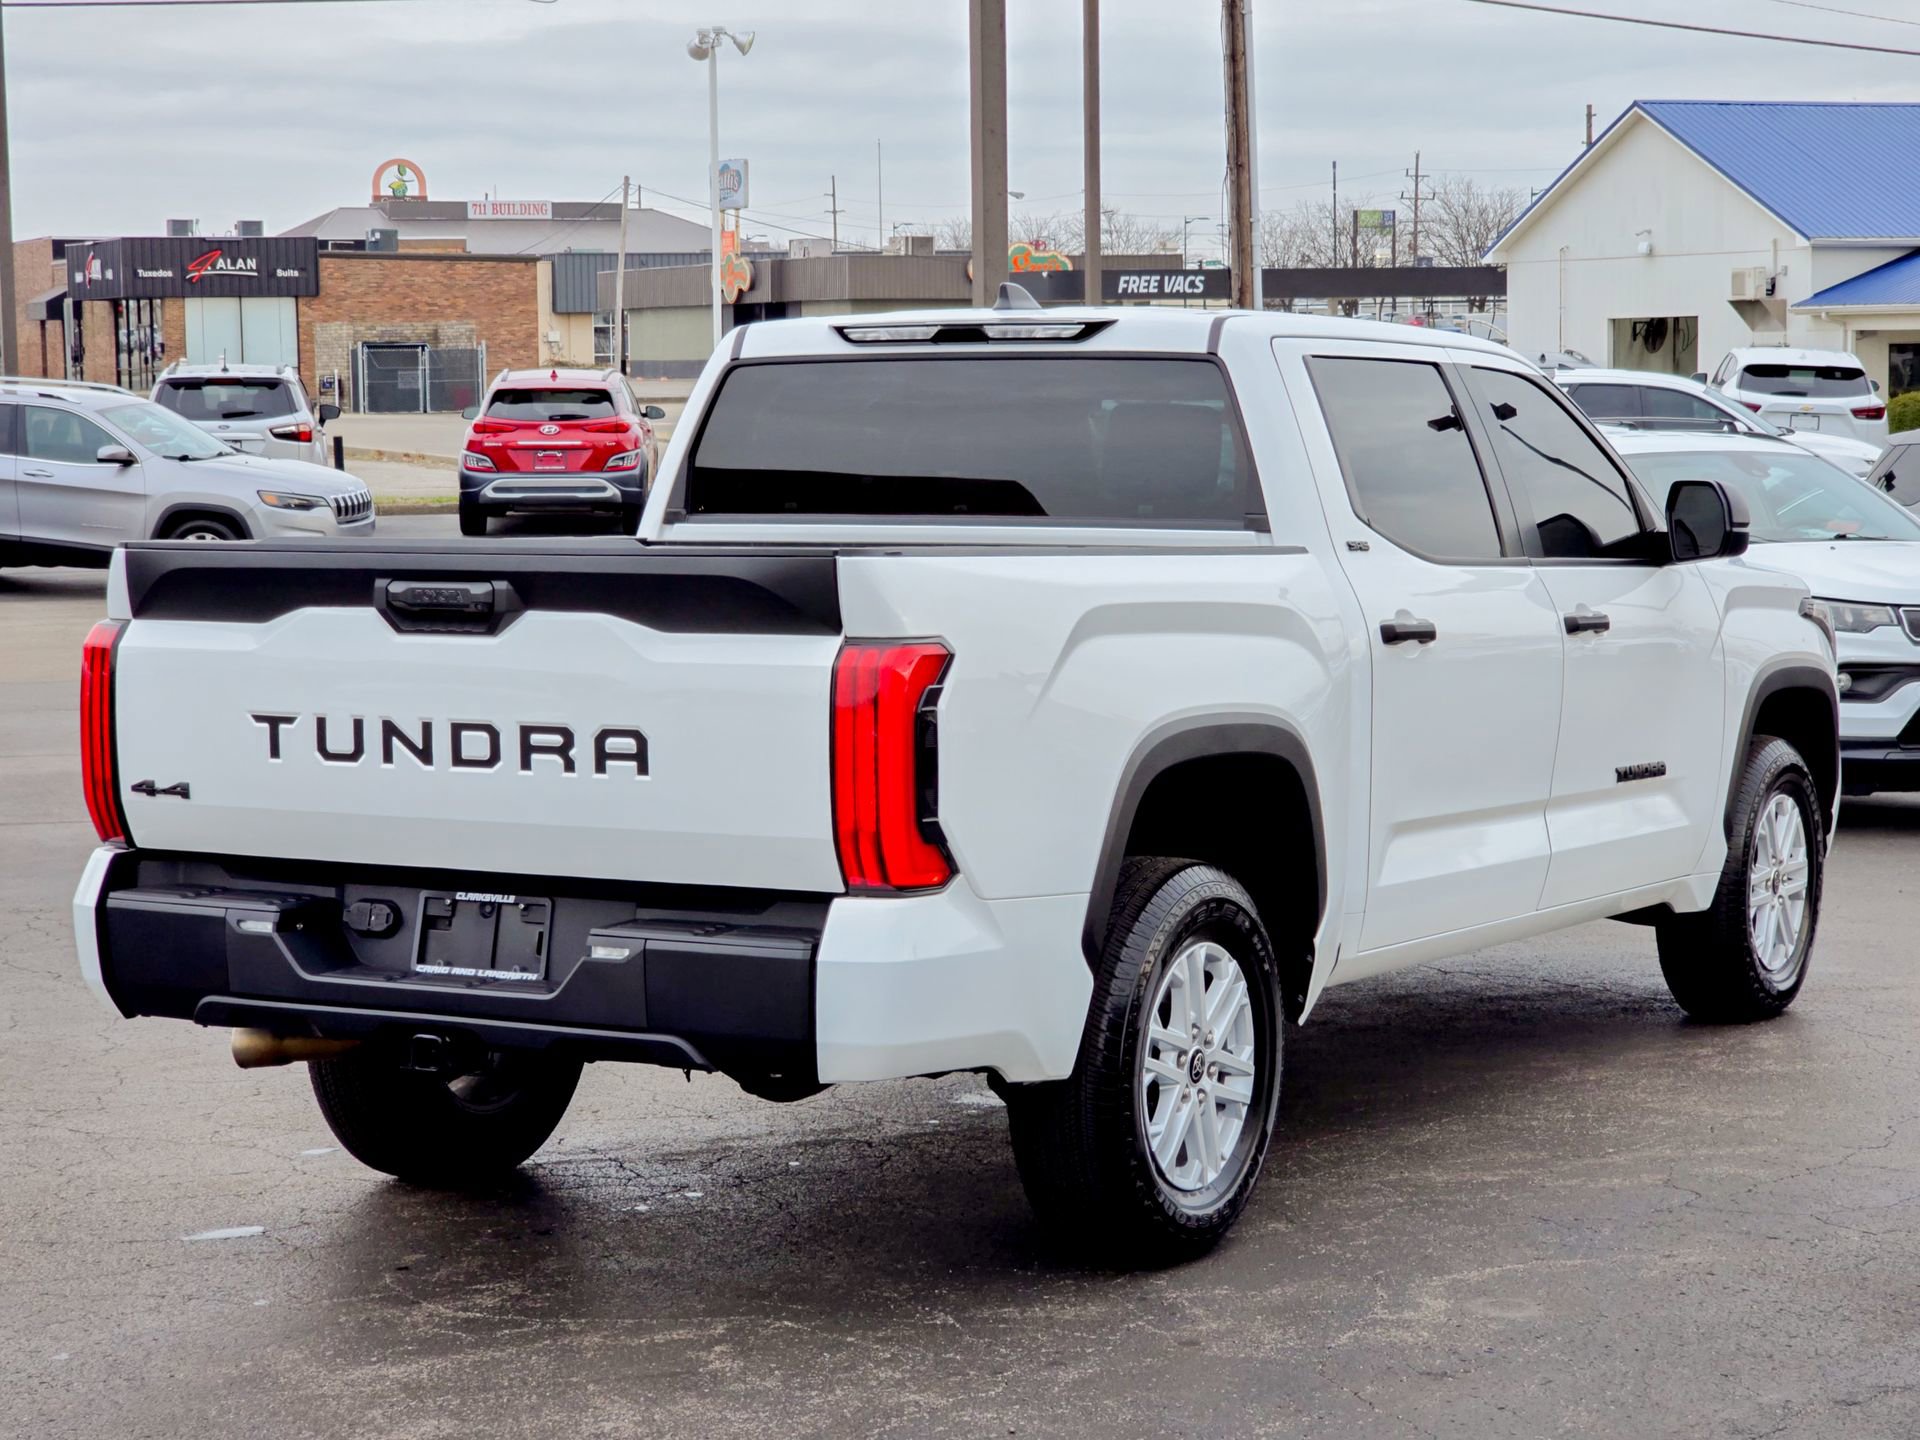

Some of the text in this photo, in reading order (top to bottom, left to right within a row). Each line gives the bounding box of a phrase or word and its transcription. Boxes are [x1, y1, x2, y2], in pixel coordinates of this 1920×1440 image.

[471, 202, 548, 216] 711 BUILDING
[216, 257, 257, 271] ALAN
[137, 269, 173, 278] Tuxedos
[276, 268, 299, 278] Suits
[1117, 275, 1205, 294] FREE VACS
[248, 712, 652, 779] TUNDRA
[455, 891, 516, 903] CLARKSVILLE
[415, 964, 449, 974] CRAIG
[451, 967, 475, 976] AND
